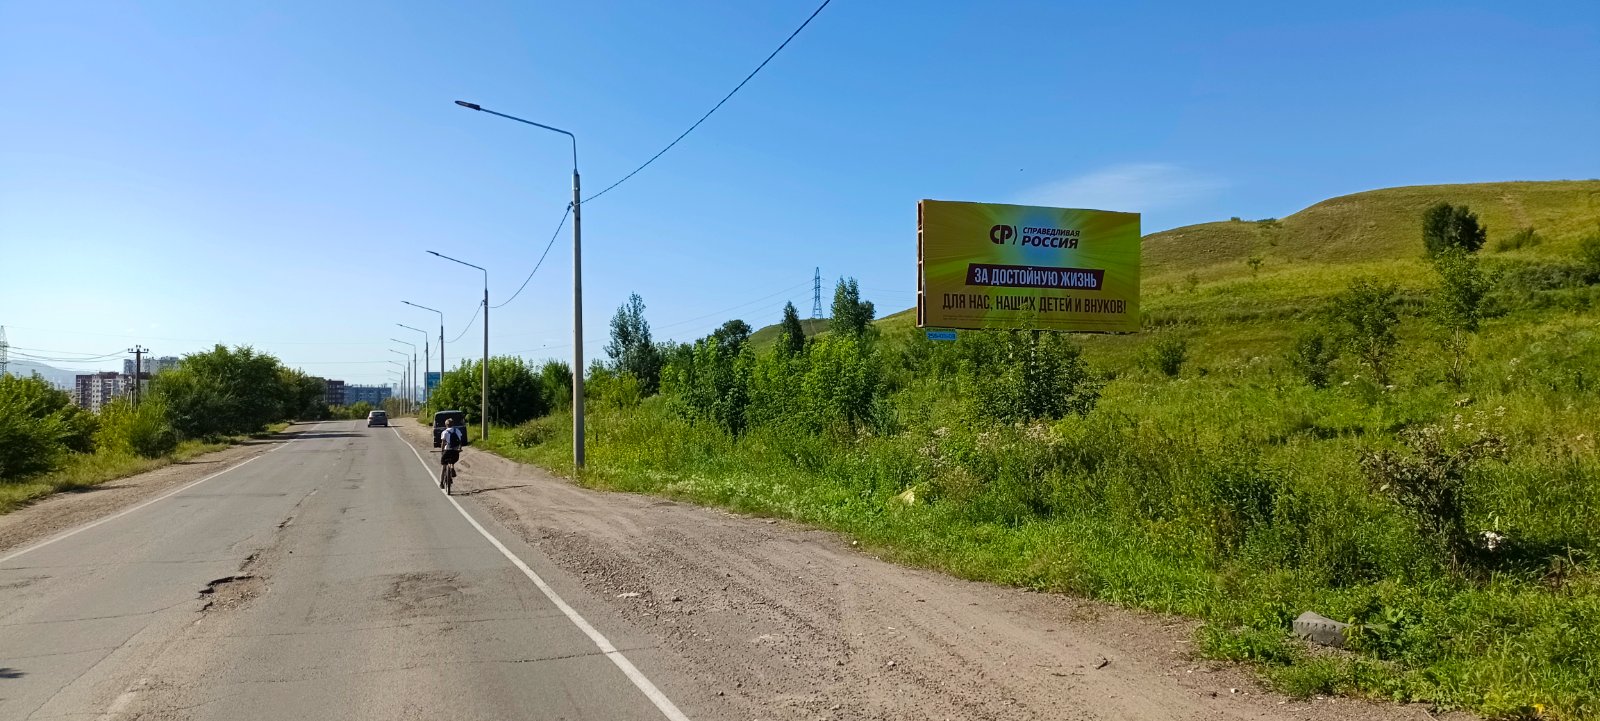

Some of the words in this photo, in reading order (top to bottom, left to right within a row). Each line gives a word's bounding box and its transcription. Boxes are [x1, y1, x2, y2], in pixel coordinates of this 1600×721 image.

[1022, 227, 1080, 237] СПРАВЕДЛИВАЯ
[1021, 235, 1079, 249] РОССИЯ
[974, 267, 989, 283] ЗА
[991, 267, 1058, 286] ДОСТОЙНУЮ
[1060, 271, 1097, 288] ЖИЗНЬ
[943, 293, 966, 310] ДЛЯ
[969, 294, 993, 312] НАС,
[1039, 295, 1073, 313] ДЕТЕЙ
[1074, 298, 1082, 313] И
[1084, 299, 1127, 314] ВНУКОВ!
